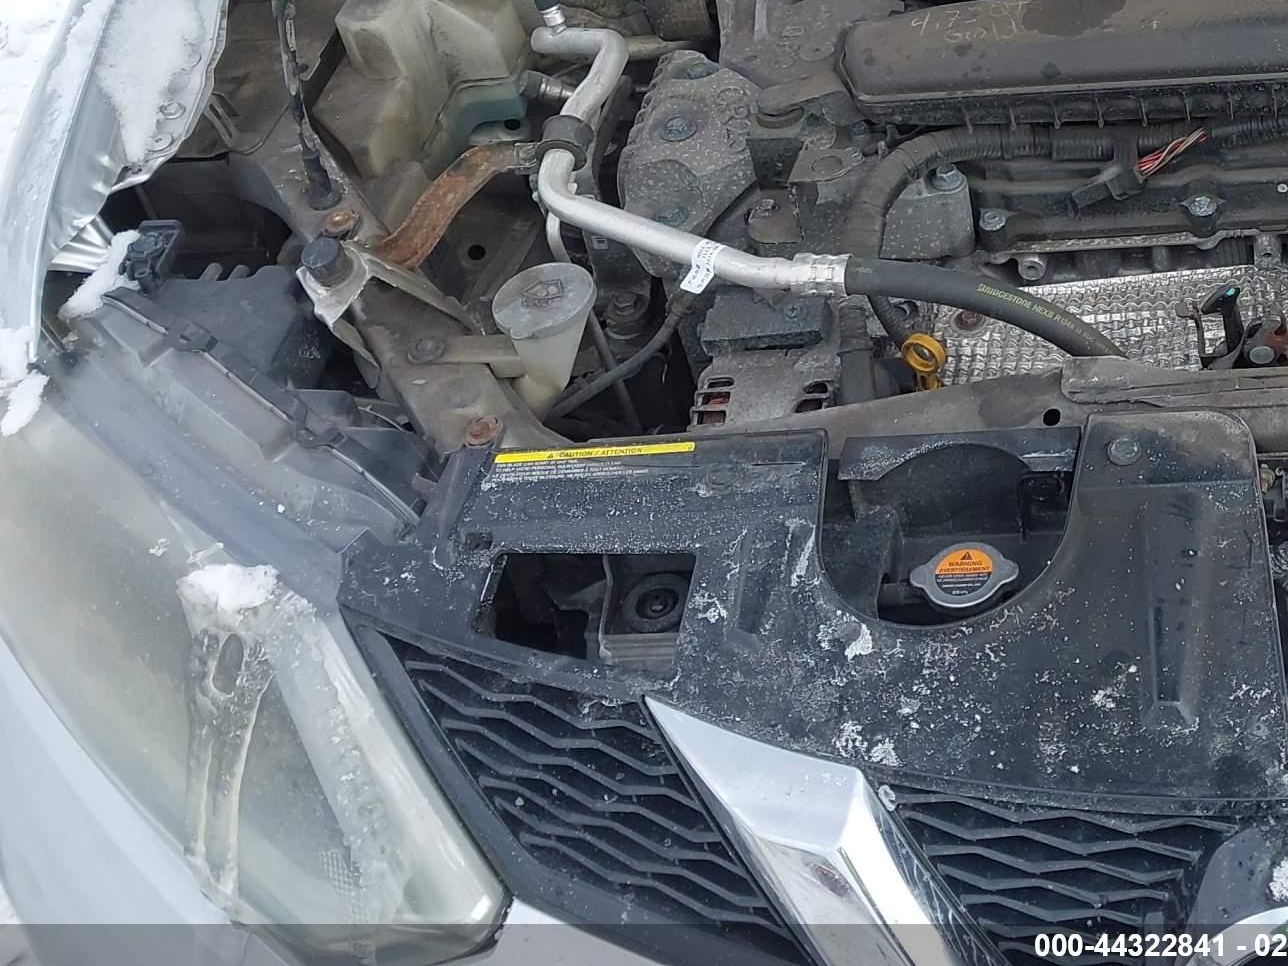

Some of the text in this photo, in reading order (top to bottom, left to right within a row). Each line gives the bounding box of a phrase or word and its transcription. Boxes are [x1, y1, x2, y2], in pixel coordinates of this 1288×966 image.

[976, 283, 1032, 308] BRIDGESTONE
[559, 450, 593, 458] CAUTION
[601, 448, 643, 456] ATTENTION
